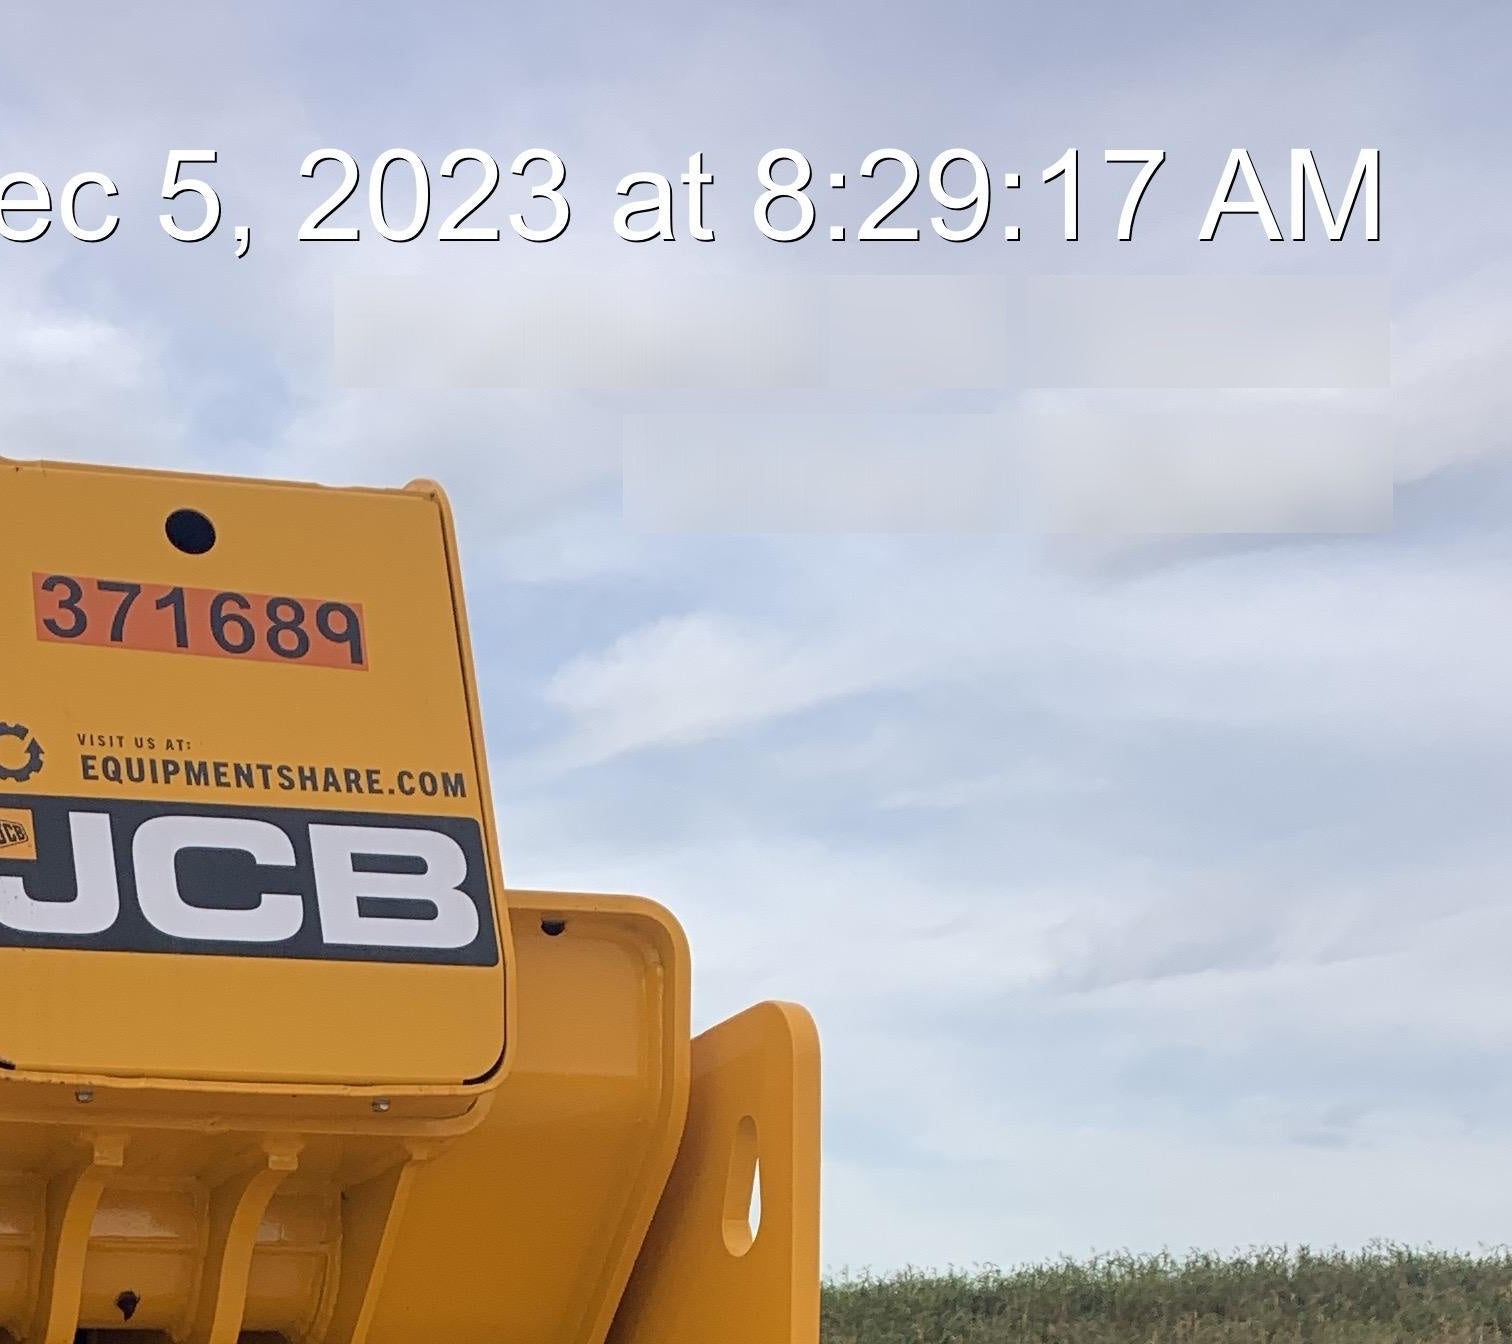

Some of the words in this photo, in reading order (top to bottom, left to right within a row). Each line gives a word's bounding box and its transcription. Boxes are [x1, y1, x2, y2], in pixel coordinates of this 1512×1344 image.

[40, 574, 364, 665] 371689
[76, 733, 124, 748] VISIT
[134, 736, 155, 750] US
[165, 738, 192, 751] AT:
[80, 754, 467, 798] EQUIPMENTSHARE.COM
